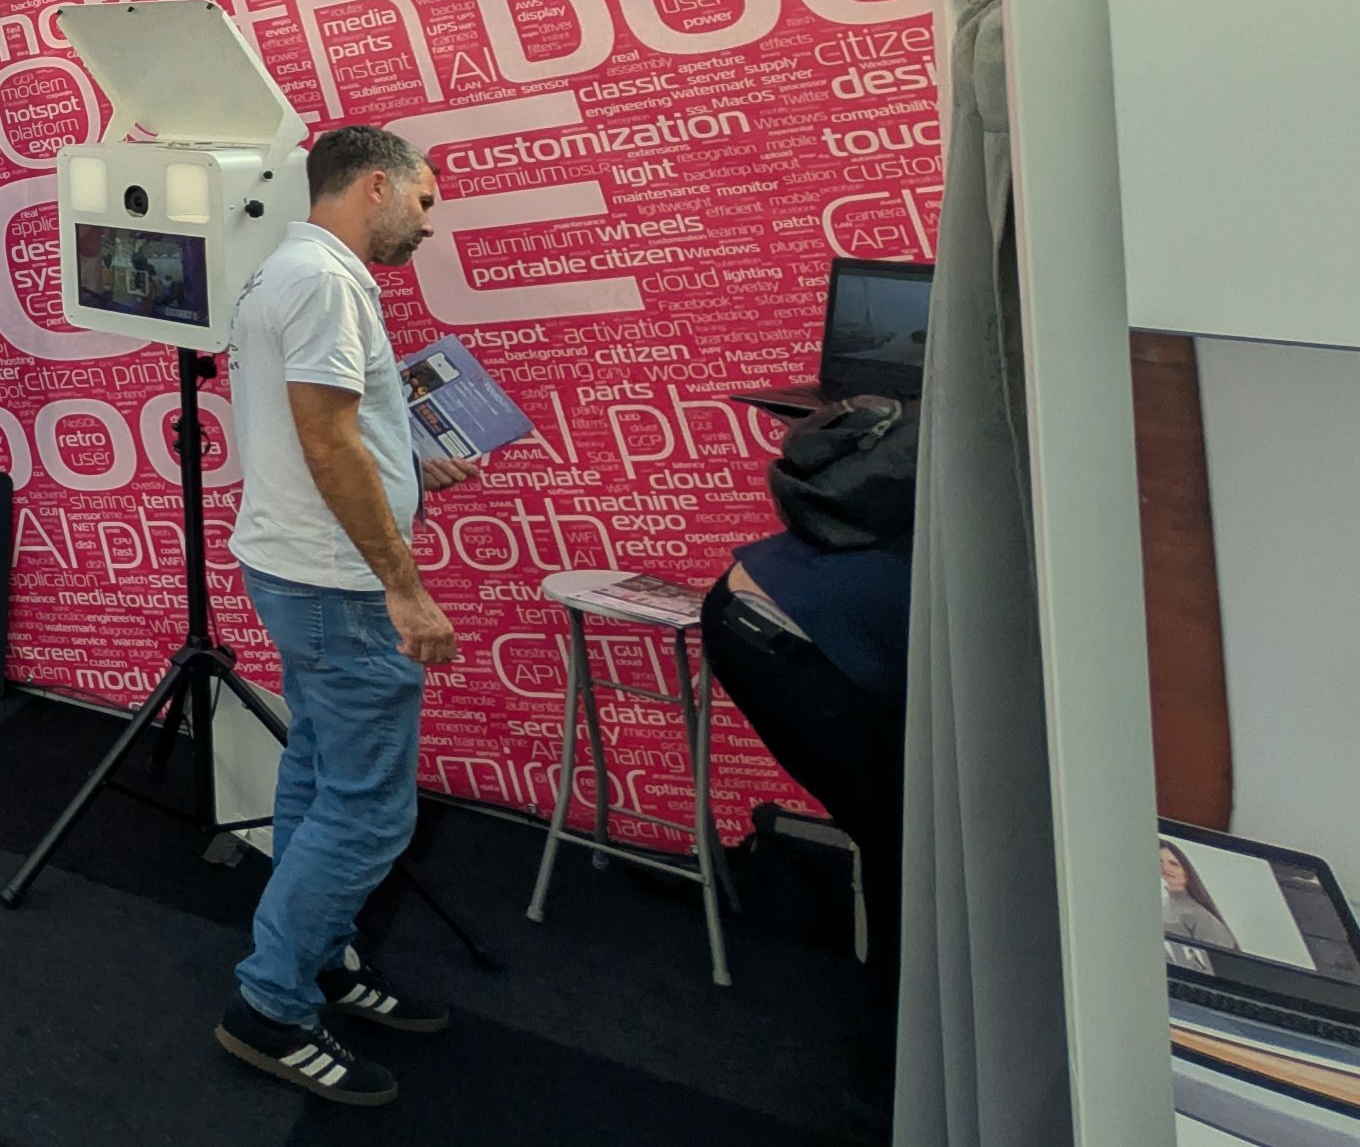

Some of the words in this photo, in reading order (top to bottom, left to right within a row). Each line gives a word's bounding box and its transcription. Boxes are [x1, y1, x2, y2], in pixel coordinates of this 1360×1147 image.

[323, 8, 398, 37] media
[517, 5, 566, 23] display
[683, 11, 733, 30] power
[264, 22, 299, 38] event
[426, 21, 458, 37] UPS
[328, 34, 393, 63] parts
[277, 60, 312, 75] DSLR
[335, 53, 413, 84] instant
[677, 53, 746, 74] aperture
[744, 57, 799, 76] supply
[521, 78, 570, 94] sensor
[579, 71, 680, 103] classic
[687, 69, 736, 86] server
[762, 69, 813, 86] server
[1, 77, 68, 101] modern
[349, 78, 422, 100] sublimation
[449, 87, 517, 108] certificate
[671, 78, 756, 100] watermark
[711, 90, 775, 110] MacOS
[5, 97, 80, 125] hotspot
[10, 118, 79, 145] platform
[446, 108, 751, 175] customization
[29, 134, 75, 153] expo
[458, 164, 565, 197] premium
[611, 158, 678, 187] light
[612, 182, 710, 204] maintenance
[716, 180, 780, 198] monitor
[772, 214, 820, 232] patch
[846, 206, 906, 222] camera
[593, 213, 705, 243] wheels
[850, 225, 911, 251] API
[466, 227, 594, 259] aluminium
[684, 242, 761, 260] Windows
[591, 245, 690, 272] citizen
[471, 254, 586, 287] portable
[641, 267, 720, 294] cloud
[723, 265, 783, 281] lighting
[562, 317, 694, 343] activation
[505, 346, 589, 361] background
[594, 344, 691, 365] citizen
[724, 347, 788, 363] MacOS
[643, 358, 727, 382] wood
[739, 360, 805, 374] transfer
[24, 367, 106, 391] citizen
[684, 377, 772, 393] watermark
[579, 380, 654, 405] parts
[59, 431, 106, 448] retro
[71, 450, 110, 467] user
[481, 467, 602, 490] template
[648, 469, 734, 490] cloud
[69, 492, 137, 512] sharing
[573, 491, 700, 512] machine
[611, 515, 687, 534] expo
[615, 535, 688, 557] retro
[58, 590, 116, 607] media
[599, 704, 666, 727] data
